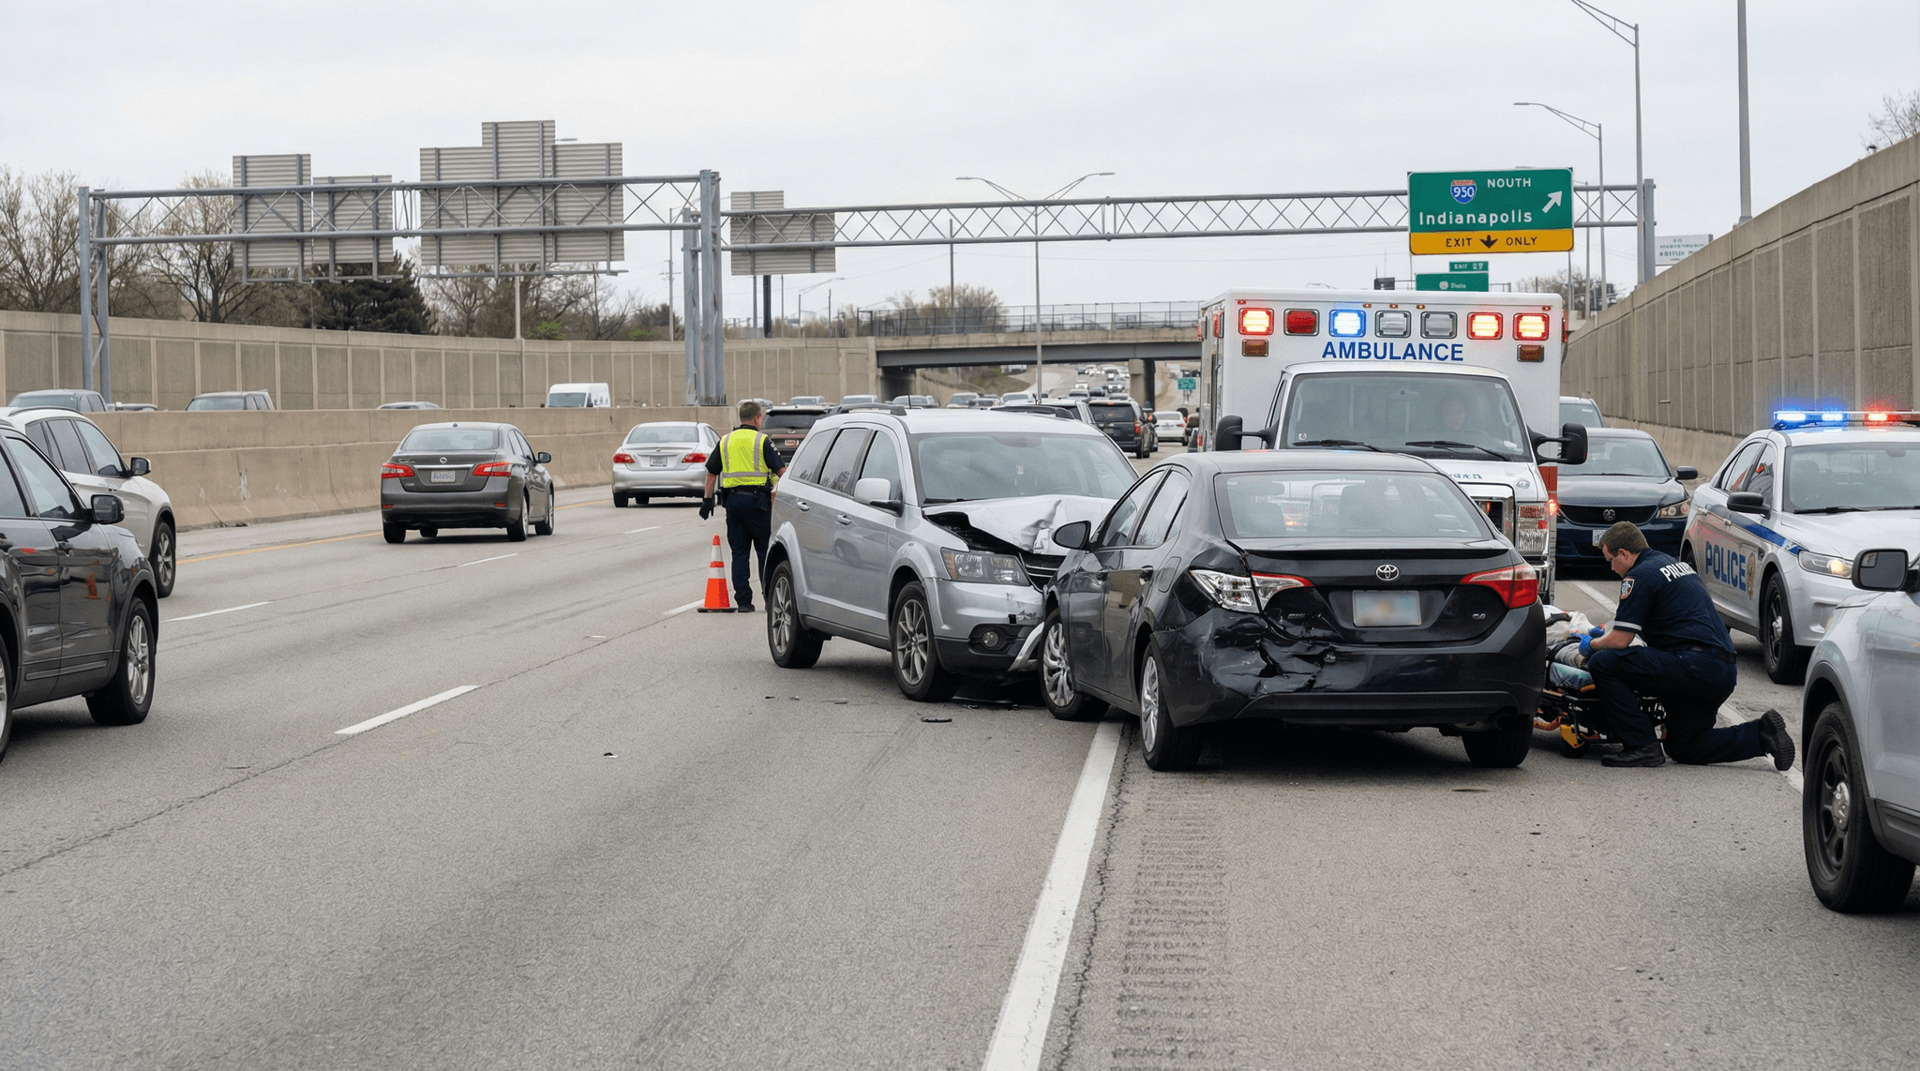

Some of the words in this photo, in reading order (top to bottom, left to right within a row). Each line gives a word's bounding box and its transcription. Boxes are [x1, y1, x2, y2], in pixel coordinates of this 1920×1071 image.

[1487, 178, 1531, 188] NOUTH
[1453, 186, 1475, 198] 950
[1419, 209, 1533, 227] Indianapolis
[1445, 238, 1473, 248] EXIT
[1505, 236, 1537, 246] ONLY
[1322, 341, 1464, 361] AMBULANCE
[1705, 540, 1747, 592] POLICE
